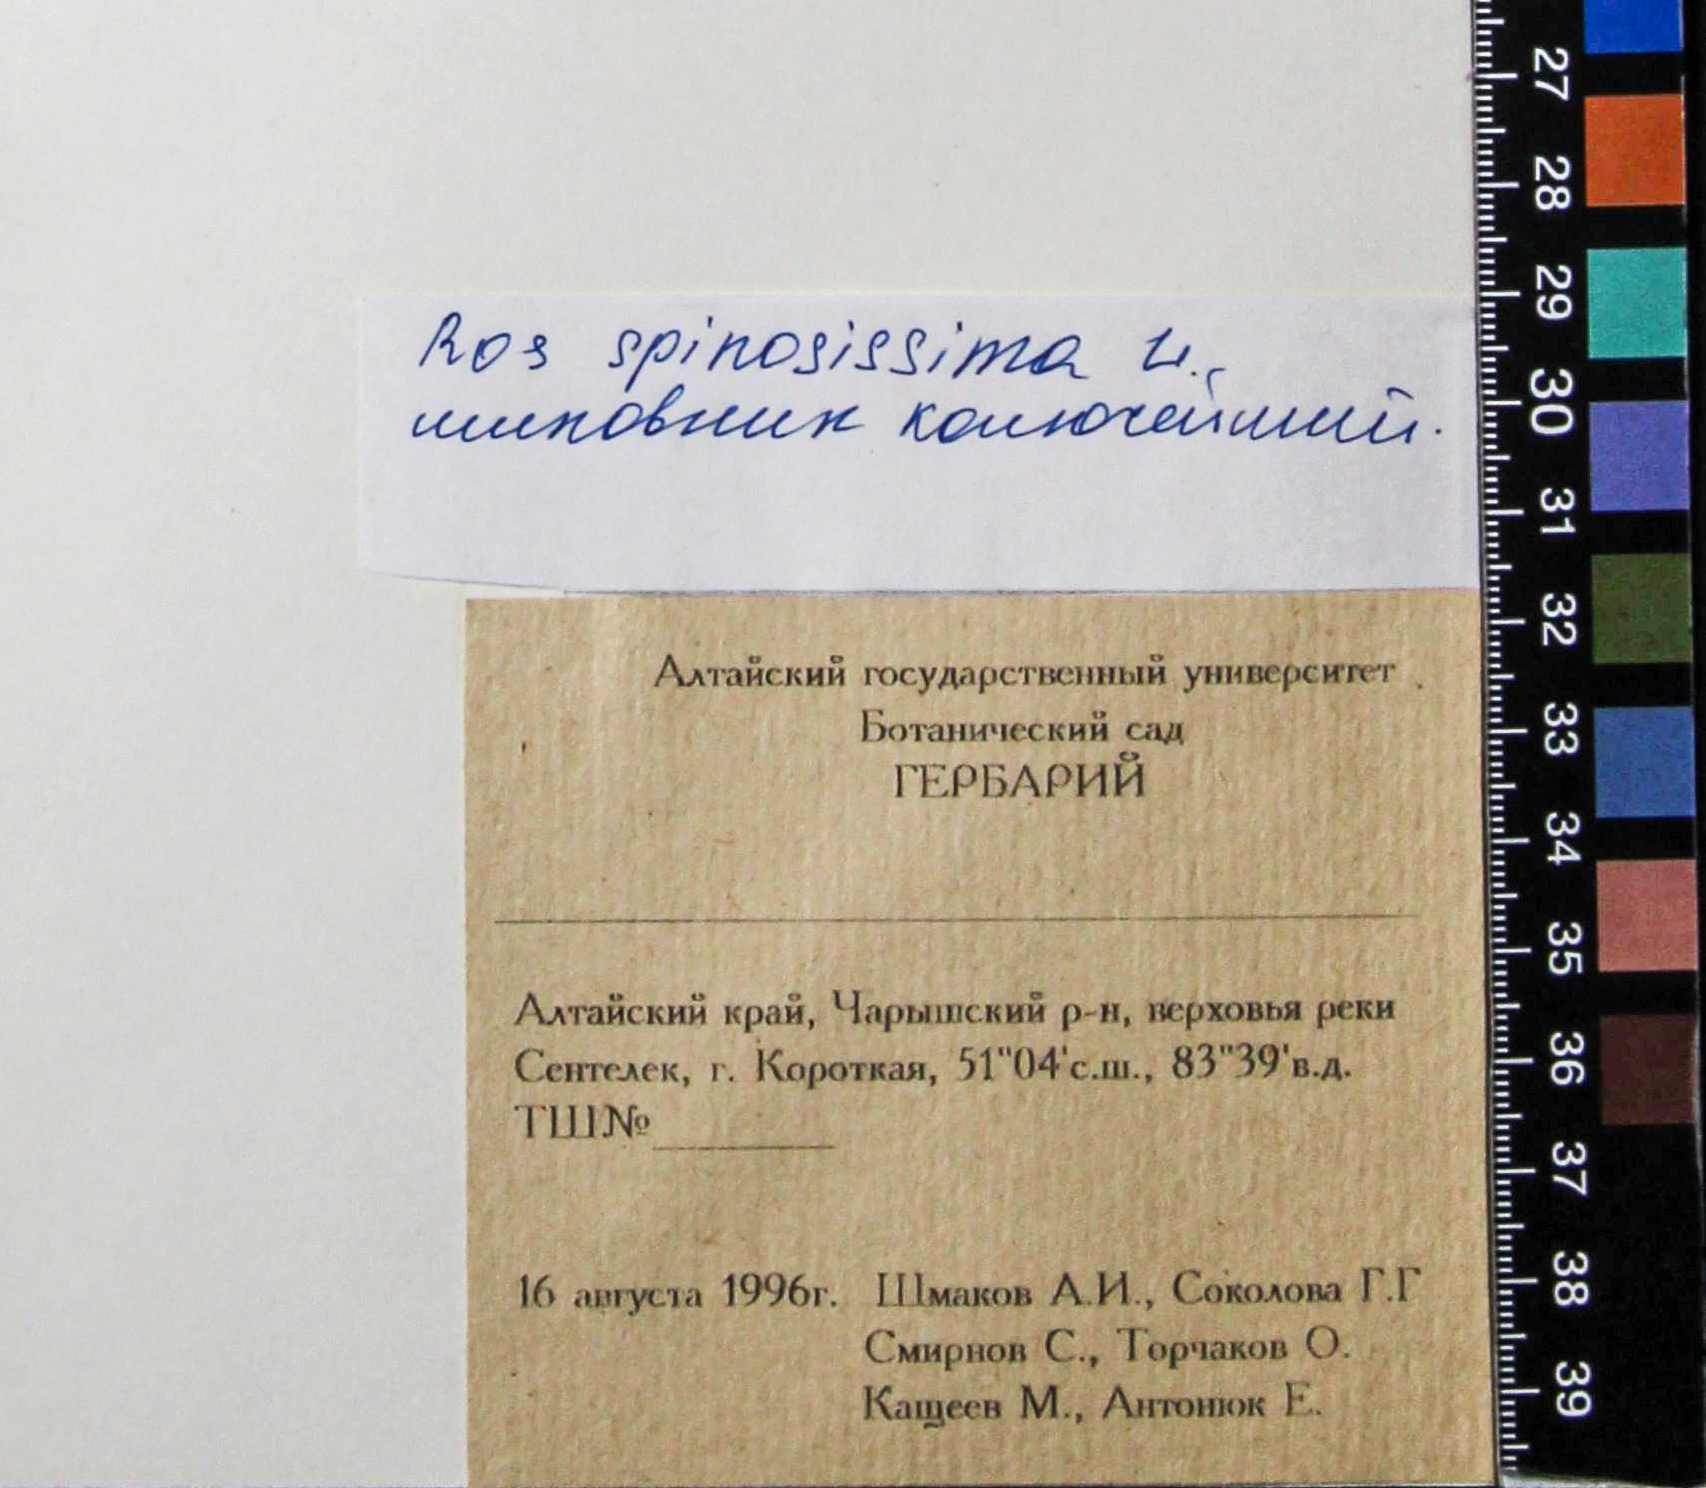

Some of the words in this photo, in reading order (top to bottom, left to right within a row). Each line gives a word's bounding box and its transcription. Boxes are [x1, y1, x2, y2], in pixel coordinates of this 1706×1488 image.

[1533, 47, 1569, 101] 27
[1534, 155, 1571, 211] 28
[1536, 264, 1573, 320] 29
[1530, 368, 1574, 435] 30
[1540, 487, 1576, 534] 31
[1541, 593, 1577, 646] 32
[653, 652, 846, 688] Алтайский
[863, 653, 1167, 697] государственный
[1182, 662, 1397, 695] университет
[860, 708, 1109, 744] Ботанический
[1123, 717, 1186, 747] сад
[1543, 702, 1579, 756] 33
[894, 750, 1146, 799] ГЕРБАРИЙ
[1546, 812, 1581, 865] 34
[1547, 921, 1583, 975] 35
[513, 990, 707, 1027] Алтайский
[723, 992, 815, 1034] край,
[831, 989, 1047, 1034] Чарышский
[1061, 1001, 1132, 1033] р-н,
[1147, 999, 1303, 1032] верховья
[1316, 999, 1396, 1030] реки
[514, 1047, 691, 1089] Сентелек,
[711, 1062, 735, 1083] г.
[756, 1048, 938, 1091] Короткая,
[1549, 1032, 1585, 1086] 36
[1551, 1141, 1587, 1195] 37
[519, 1273, 557, 1309] 16
[573, 1286, 703, 1318] августа
[722, 1272, 837, 1308] 1996г.
[876, 1271, 1033, 1308] Шмаков
[1171, 1268, 1343, 1305] Соколова
[1553, 1251, 1589, 1307] 38
[864, 1328, 1028, 1372] Смирнов
[1044, 1327, 1100, 1370] С.,
[1115, 1326, 1289, 1370] Торчаков
[1305, 1324, 1350, 1360] О.
[862, 1384, 1002, 1430] Кащеев
[1020, 1383, 1084, 1425] М.,
[1101, 1383, 1266, 1420] Антонюк
[1285, 1380, 1322, 1417] Е.
[1555, 1361, 1592, 1417] 39
